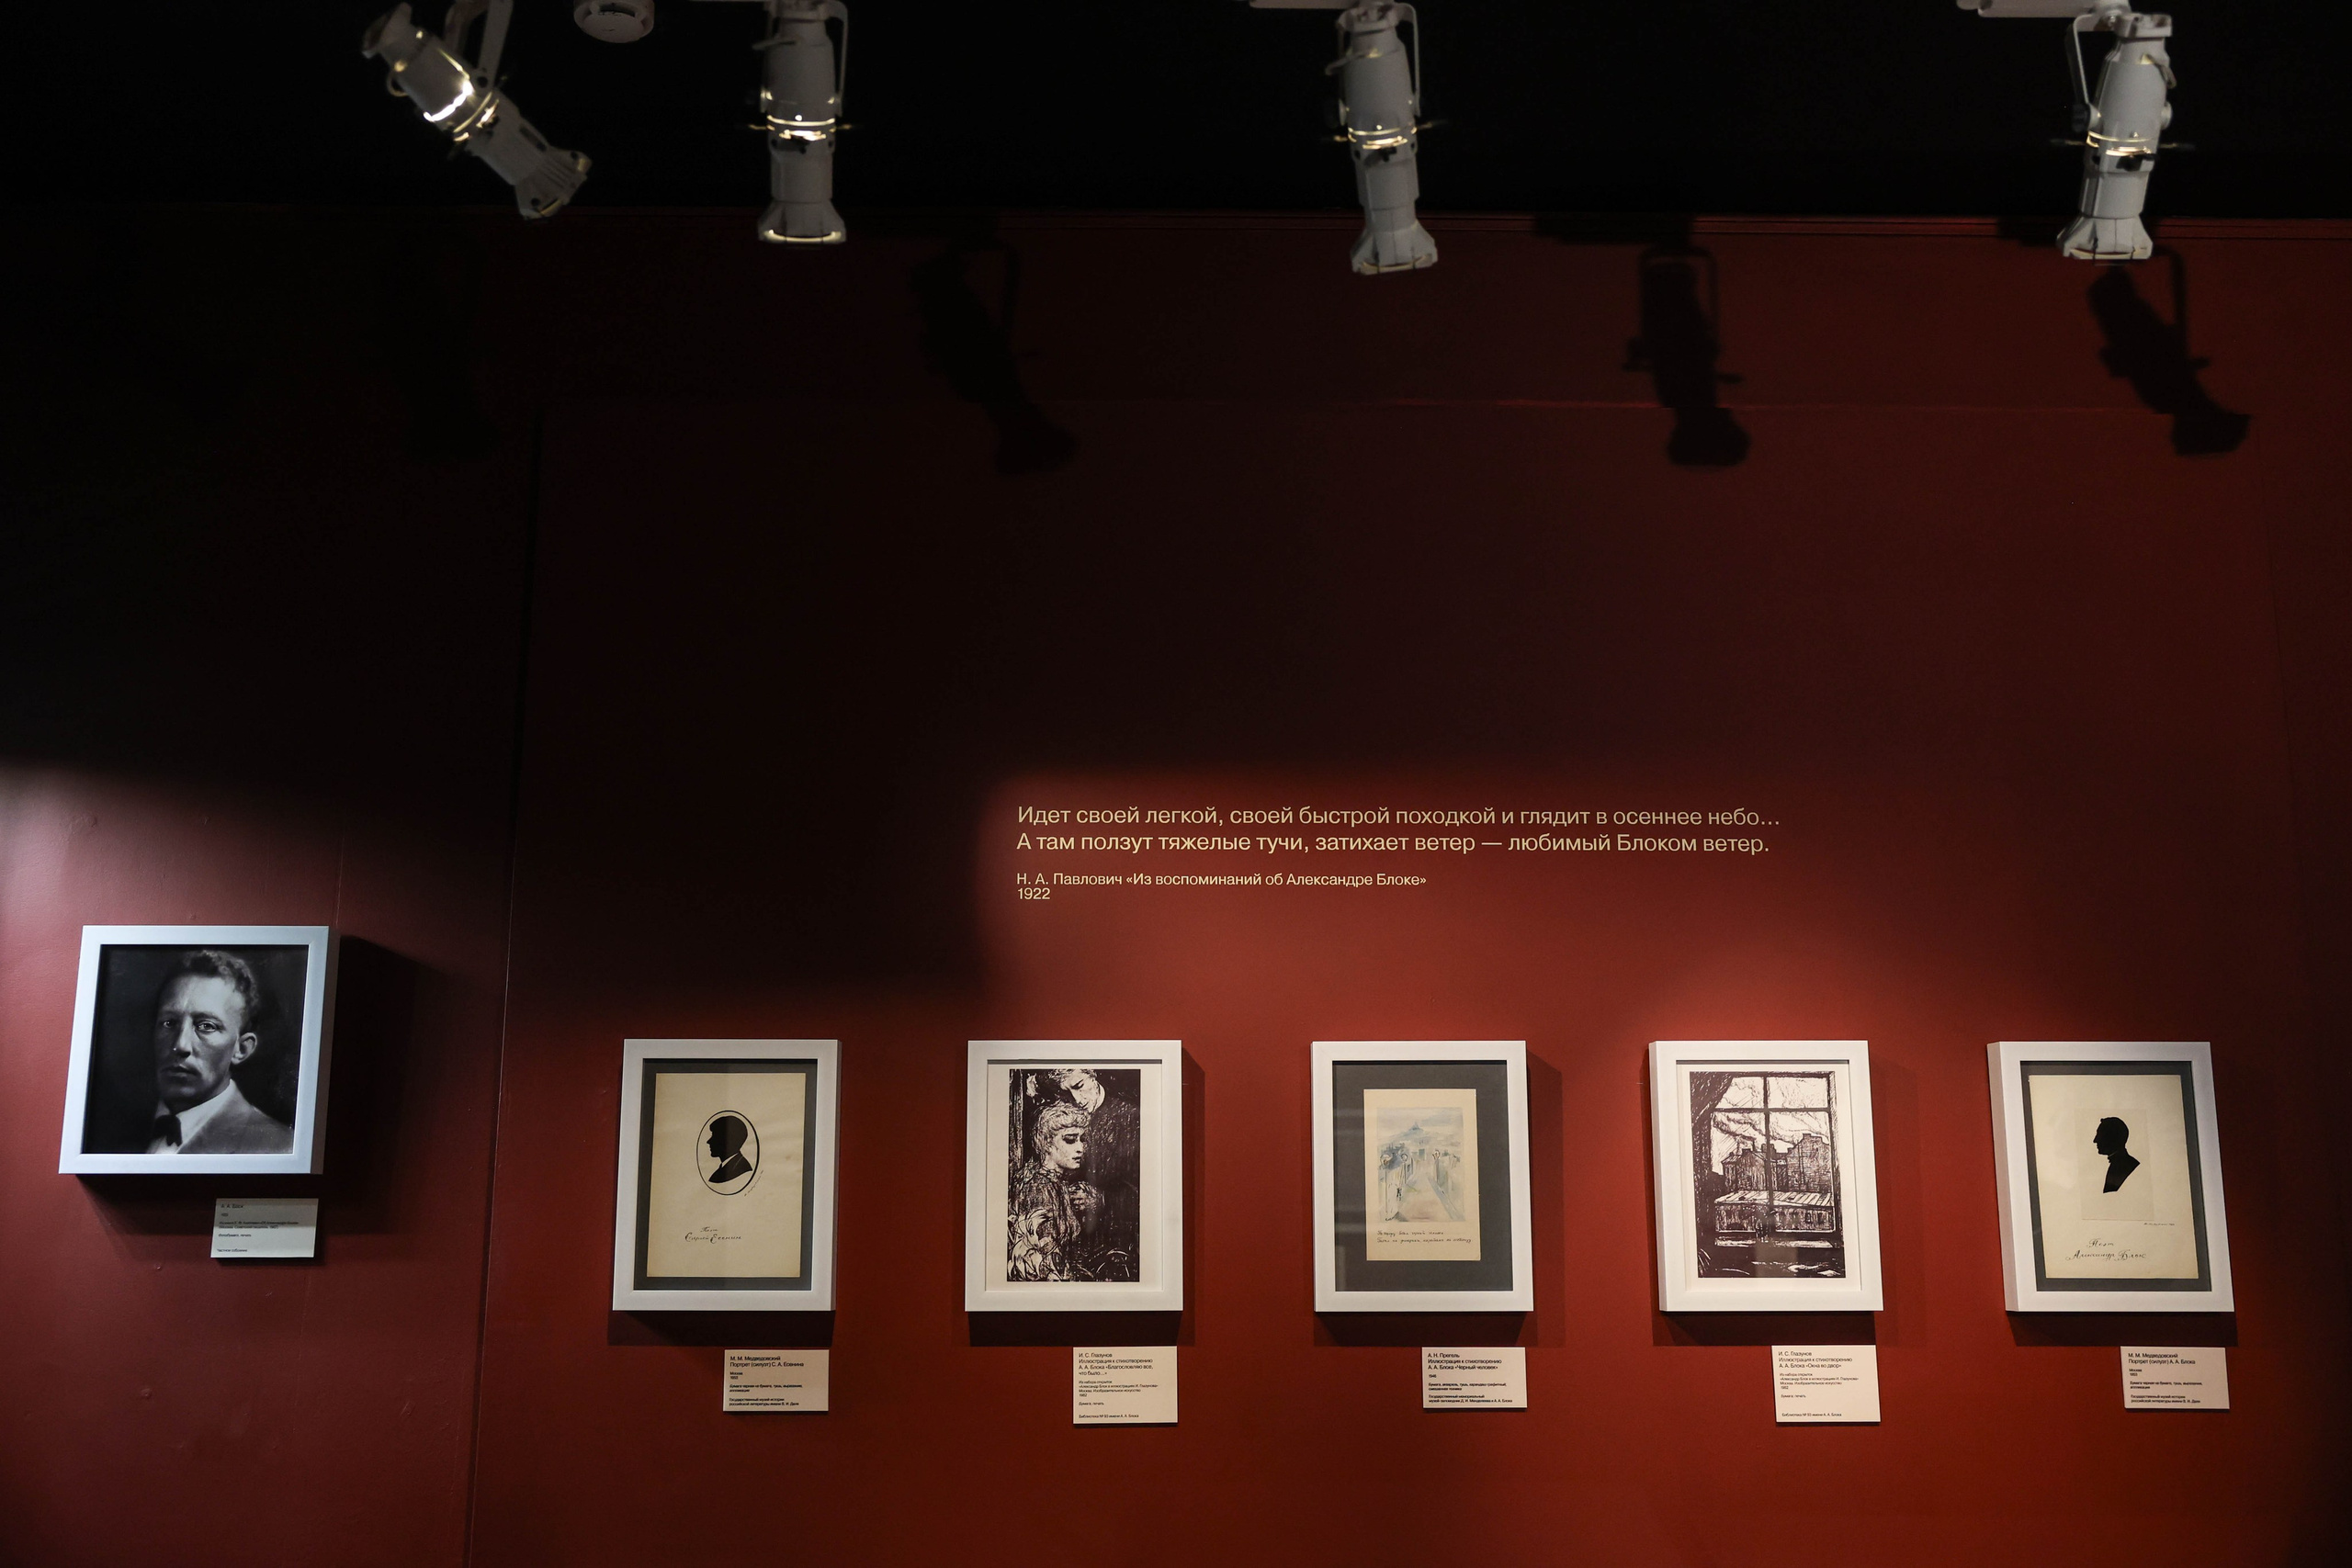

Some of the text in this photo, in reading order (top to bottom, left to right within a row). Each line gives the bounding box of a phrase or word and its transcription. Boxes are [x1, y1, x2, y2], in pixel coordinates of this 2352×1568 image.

[1018, 806, 1071, 826] Идет
[1076, 806, 1139, 824] своей
[1144, 806, 1224, 827] легкой,
[1229, 807, 1294, 824] своей
[1299, 805, 1390, 828] быстрой
[1396, 807, 1496, 828] походкой
[1501, 811, 1514, 824] и
[1520, 811, 1591, 828] глядит
[1596, 811, 1608, 825] в
[1612, 811, 1702, 826] осеннее
[1016, 832, 1032, 850] А
[1035, 836, 1075, 851] там
[1080, 836, 1154, 854] ползут
[1158, 836, 1251, 851] тяжелые
[1255, 837, 1309, 854] тучи,
[1315, 837, 1410, 852] затихает
[1415, 837, 1476, 855] ветер
[1508, 832, 1611, 852] любимый
[1617, 833, 1697, 852] Блоком
[1702, 838, 1770, 856] ветер.
[1016, 872, 1427, 888] Н. А. Павлович «Из воспоминаний об Александре Блоке»
[1017, 887, 1051, 900] 1922
[709, 1233, 741, 1245] Есенин
[2086, 1238, 2114, 1248] Поэт
[2114, 1249, 2147, 1261] Блок
